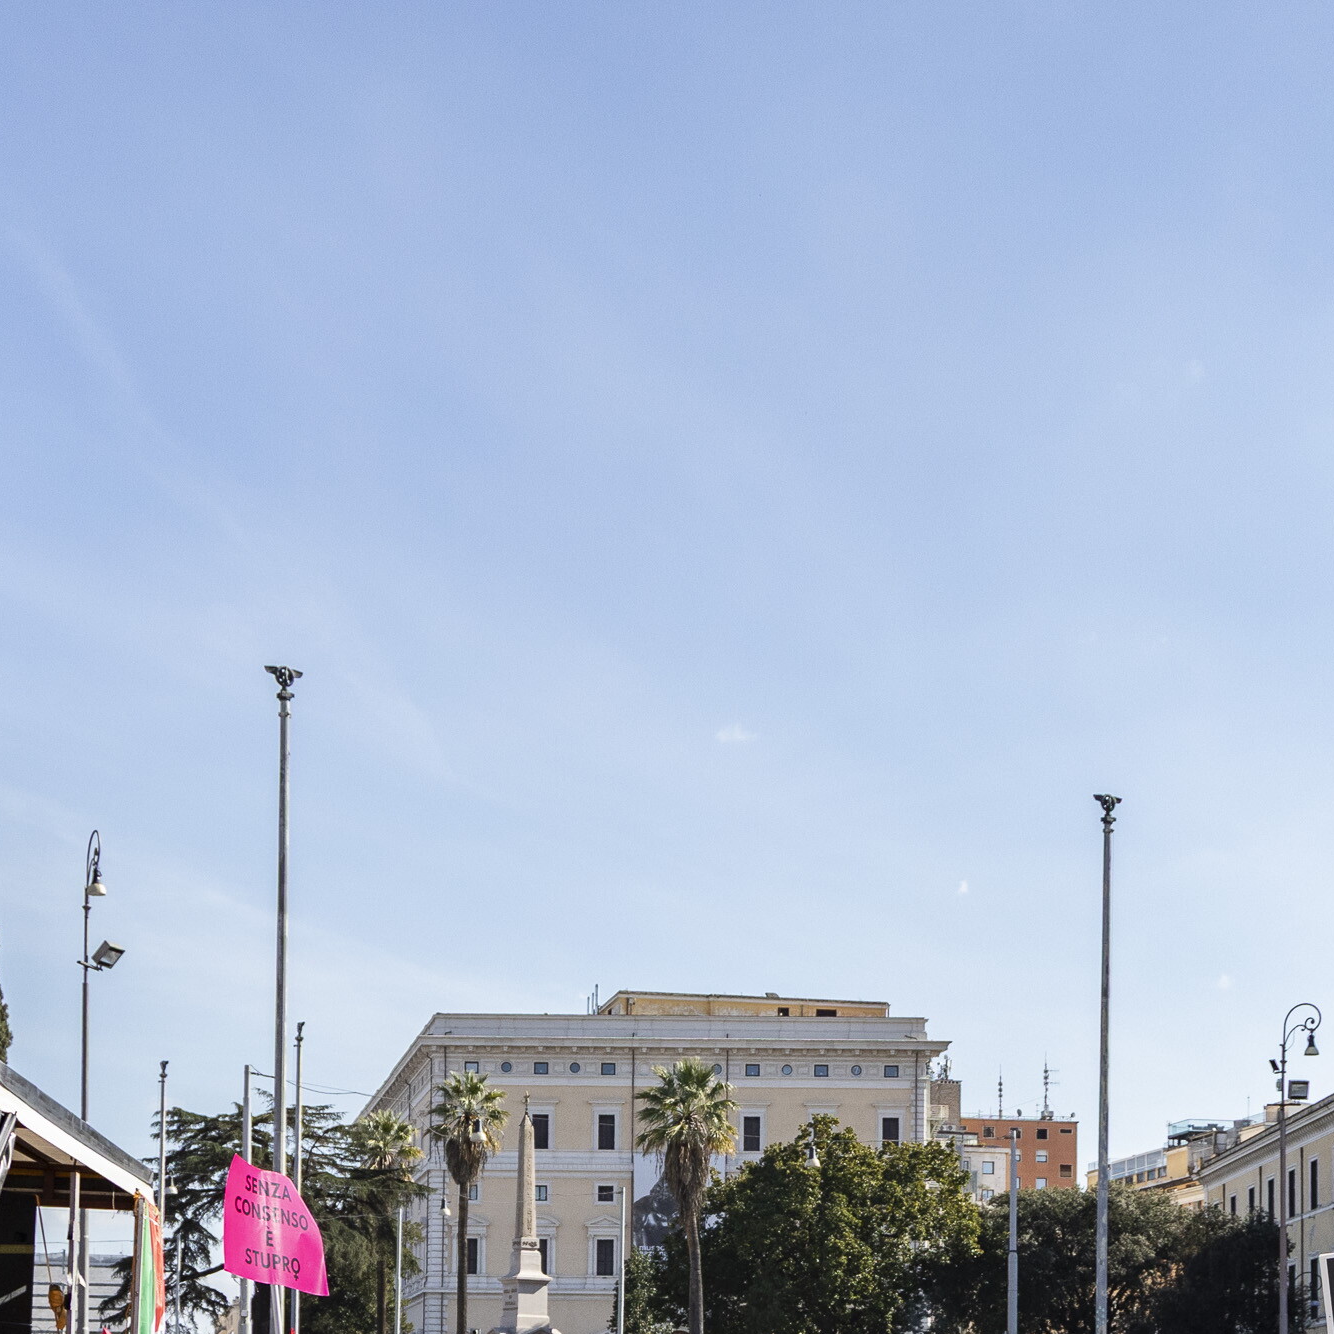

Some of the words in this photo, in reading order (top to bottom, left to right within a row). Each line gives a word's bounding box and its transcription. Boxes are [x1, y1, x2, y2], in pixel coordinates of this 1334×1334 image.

[245, 1174, 292, 1202] SENZA
[234, 1196, 308, 1231] CONSENSO
[265, 1225, 274, 1247] È
[244, 1248, 301, 1280] STUPRO
